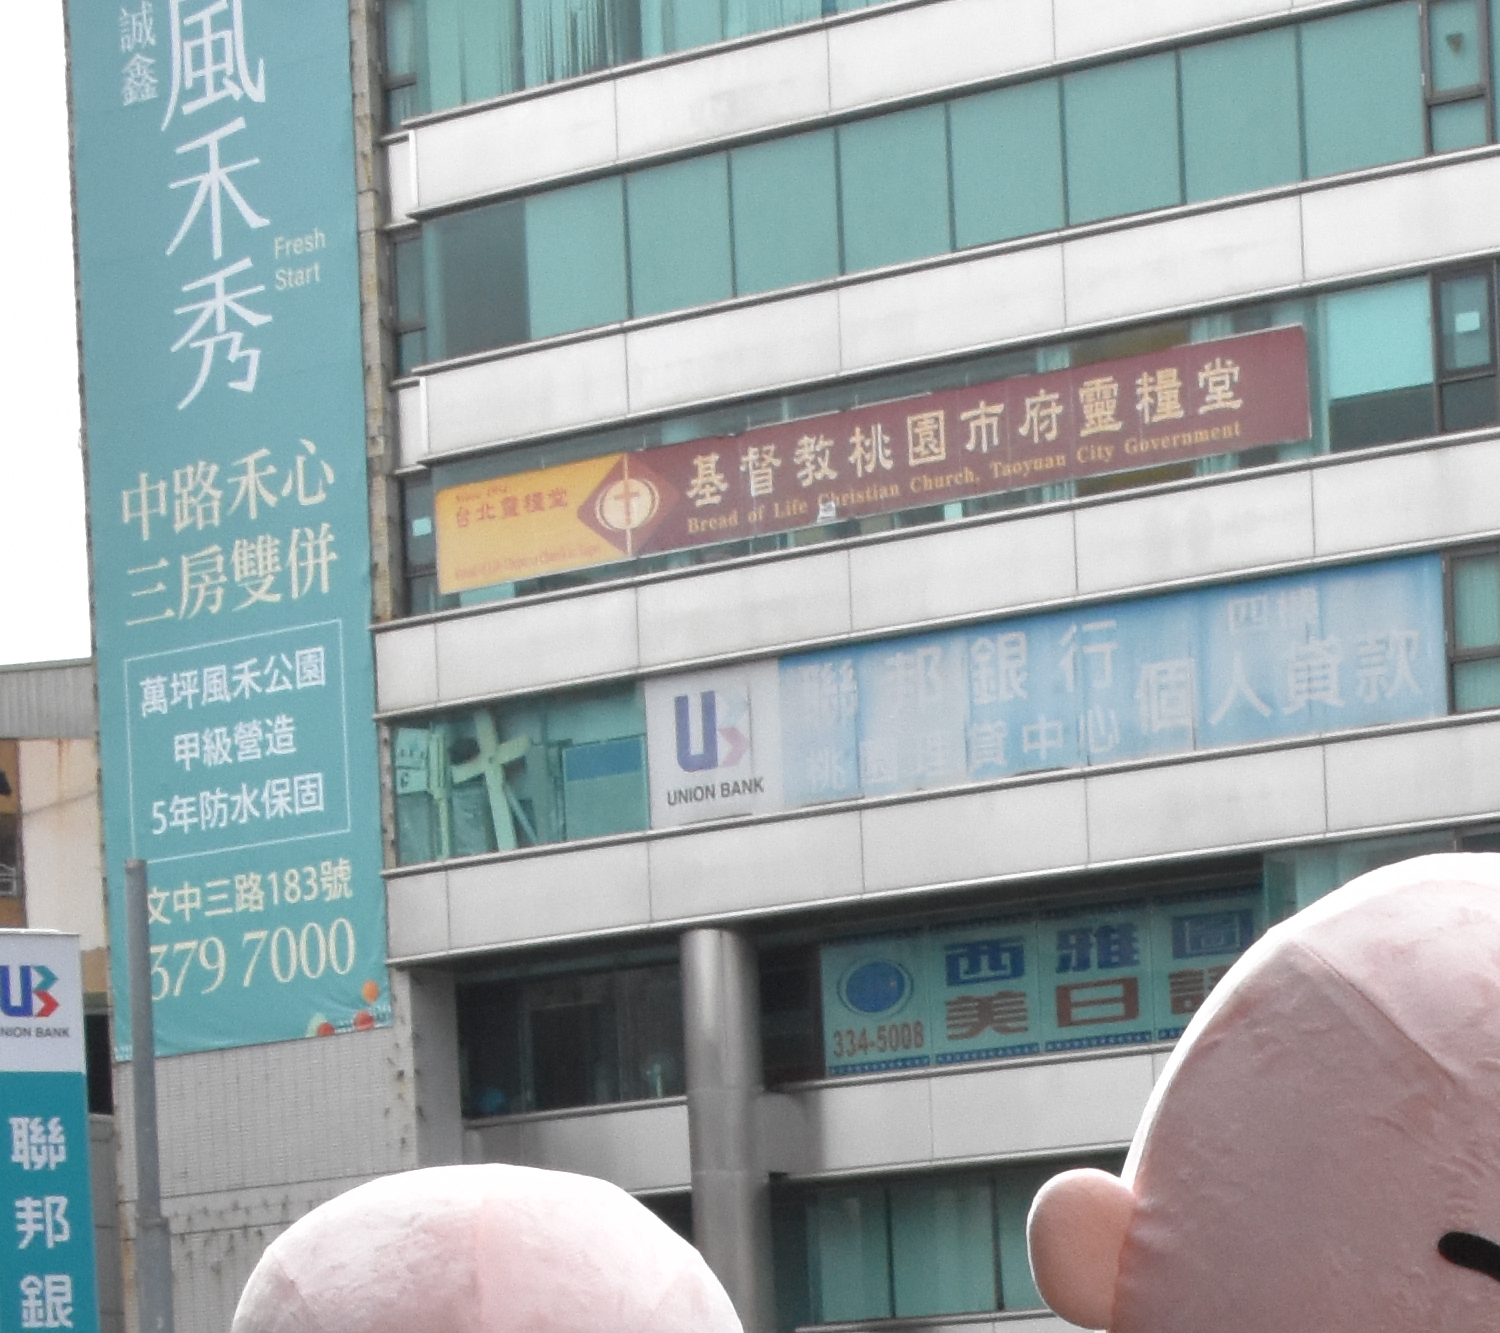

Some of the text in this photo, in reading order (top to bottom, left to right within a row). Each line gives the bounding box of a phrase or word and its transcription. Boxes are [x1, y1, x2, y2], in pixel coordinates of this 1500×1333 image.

[119, 1, 158, 106] 誠鑫
[160, 0, 273, 411] 風禾秀
[274, 228, 326, 260] Fresh
[275, 262, 321, 291] Start
[686, 357, 1244, 507] 基督教桃園市府靈糧堂
[121, 438, 335, 542] 中路禾心
[687, 509, 739, 534] Bread
[748, 504, 765, 523] of
[774, 499, 808, 520] Life
[818, 483, 900, 509] Christian
[990, 453, 1066, 480] Taoyuan
[1076, 440, 1115, 463] City
[1125, 420, 1243, 455] Government
[125, 522, 337, 627] 三房雙併
[139, 647, 326, 718] 萬坪風禾公園
[173, 714, 297, 771] 甲級營造
[151, 773, 325, 835] 5年防水保固
[667, 777, 765, 806] UNION BANK
[147, 858, 354, 927] 文中三路183號
[242, 917, 357, 988] 7000
[35, 1027, 70, 1039] BANK
